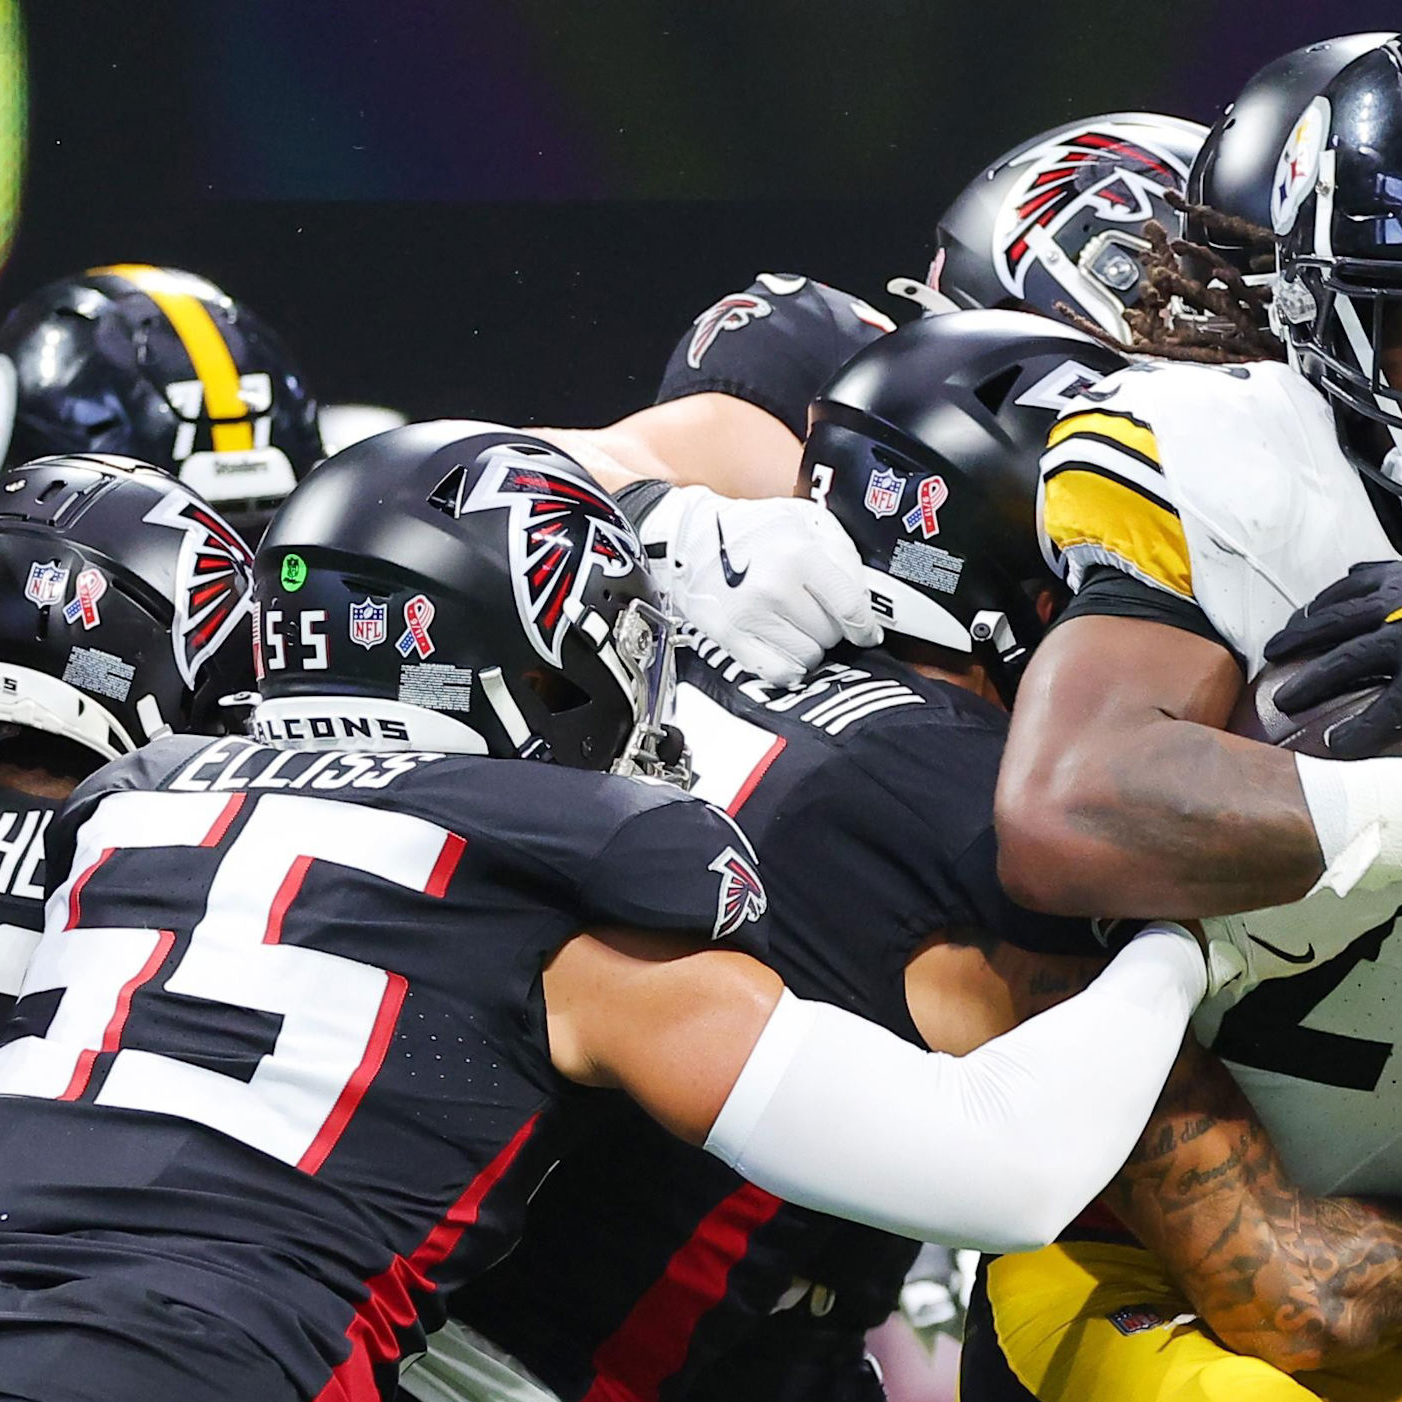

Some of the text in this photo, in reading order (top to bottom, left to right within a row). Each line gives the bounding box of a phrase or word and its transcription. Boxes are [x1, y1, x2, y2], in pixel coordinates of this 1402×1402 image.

[871, 489, 895, 510] NFL
[355, 621, 381, 639] NFL
[409, 617, 425, 638] 9/11
[265, 609, 329, 670] 55
[167, 735, 445, 792] ELLISS
